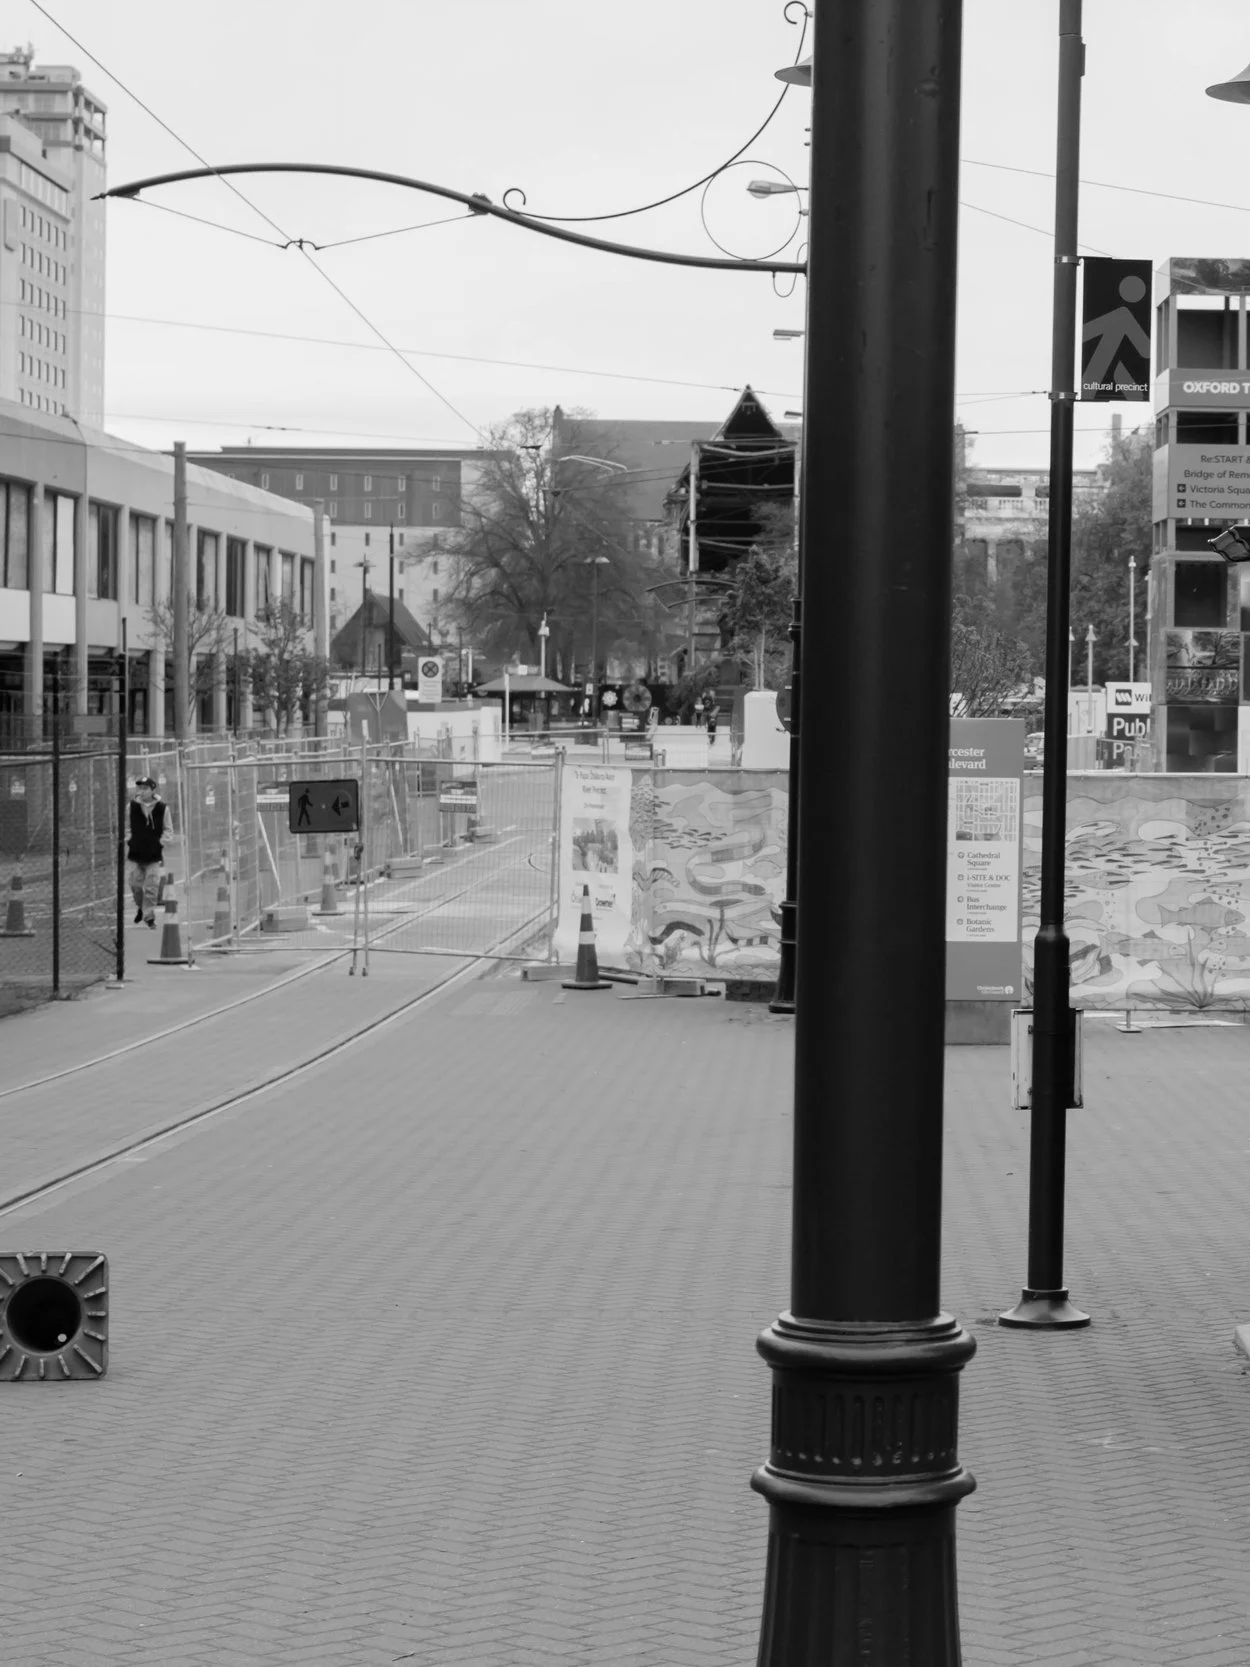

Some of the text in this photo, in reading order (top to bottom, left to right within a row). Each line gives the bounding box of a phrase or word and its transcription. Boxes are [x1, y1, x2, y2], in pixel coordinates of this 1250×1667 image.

[1083, 382, 1148, 392] cultural precinct
[1182, 381, 1240, 395] OXFORD
[1184, 469, 1215, 480] Bridge
[1217, 470, 1227, 479] of
[1190, 484, 1225, 494] Victoria
[1190, 499, 1207, 509] The
[966, 851, 1001, 859] Cathedral
[966, 858, 992, 867] Square
[966, 895, 980, 903] Bus
[966, 903, 1008, 912] Interchange
[966, 918, 993, 926] Botanic
